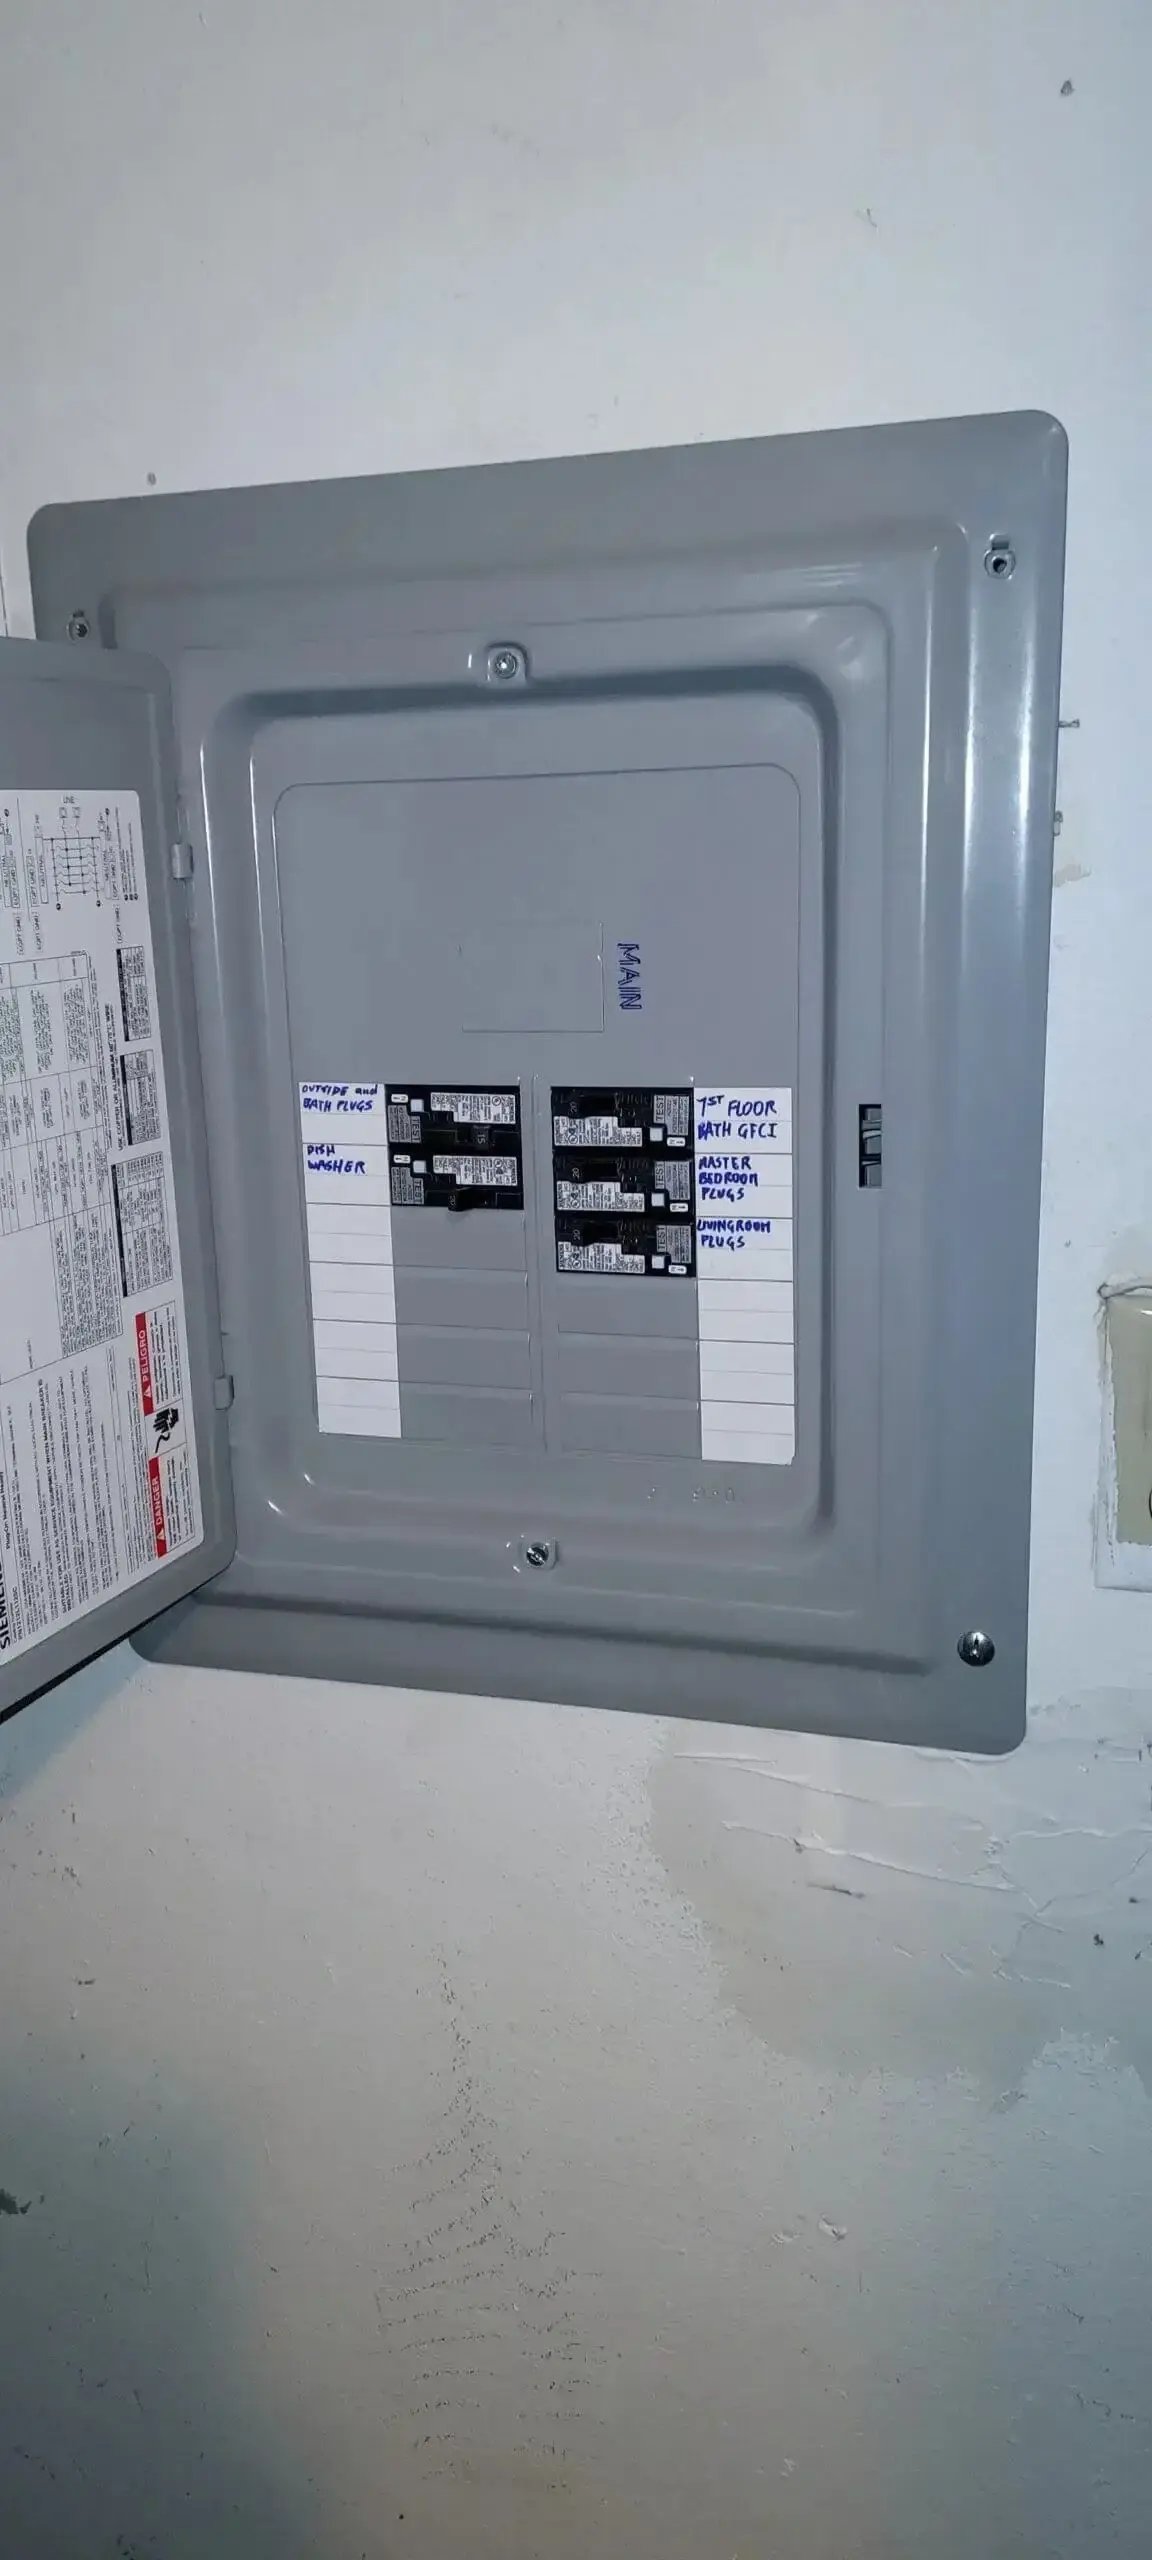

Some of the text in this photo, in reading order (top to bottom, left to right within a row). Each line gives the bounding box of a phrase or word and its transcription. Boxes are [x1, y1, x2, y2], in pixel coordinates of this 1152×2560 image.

[617, 943, 642, 1010] MAIN
[355, 1083, 378, 1095] and
[303, 1098, 373, 1112] BATH PLUGS
[655, 1096, 664, 1121] TEST
[727, 1100, 777, 1116] FLOOR
[412, 1118, 420, 1142] TEST
[697, 1121, 777, 1141] BATH GFCI
[306, 1144, 335, 1156] DISH
[307, 1159, 366, 1174] WASHER
[699, 1156, 752, 1170] MASTER
[655, 1162, 664, 1187] TEST
[698, 1172, 758, 1187] BEDROOM
[414, 1180, 422, 1203] TEST
[701, 1187, 744, 1202] PLUGS
[657, 1226, 666, 1251] TEST
[700, 1234, 745, 1251] PLUGS
[138, 1329, 150, 1383] PELIGRO
[151, 1475, 163, 1527] DANGER
